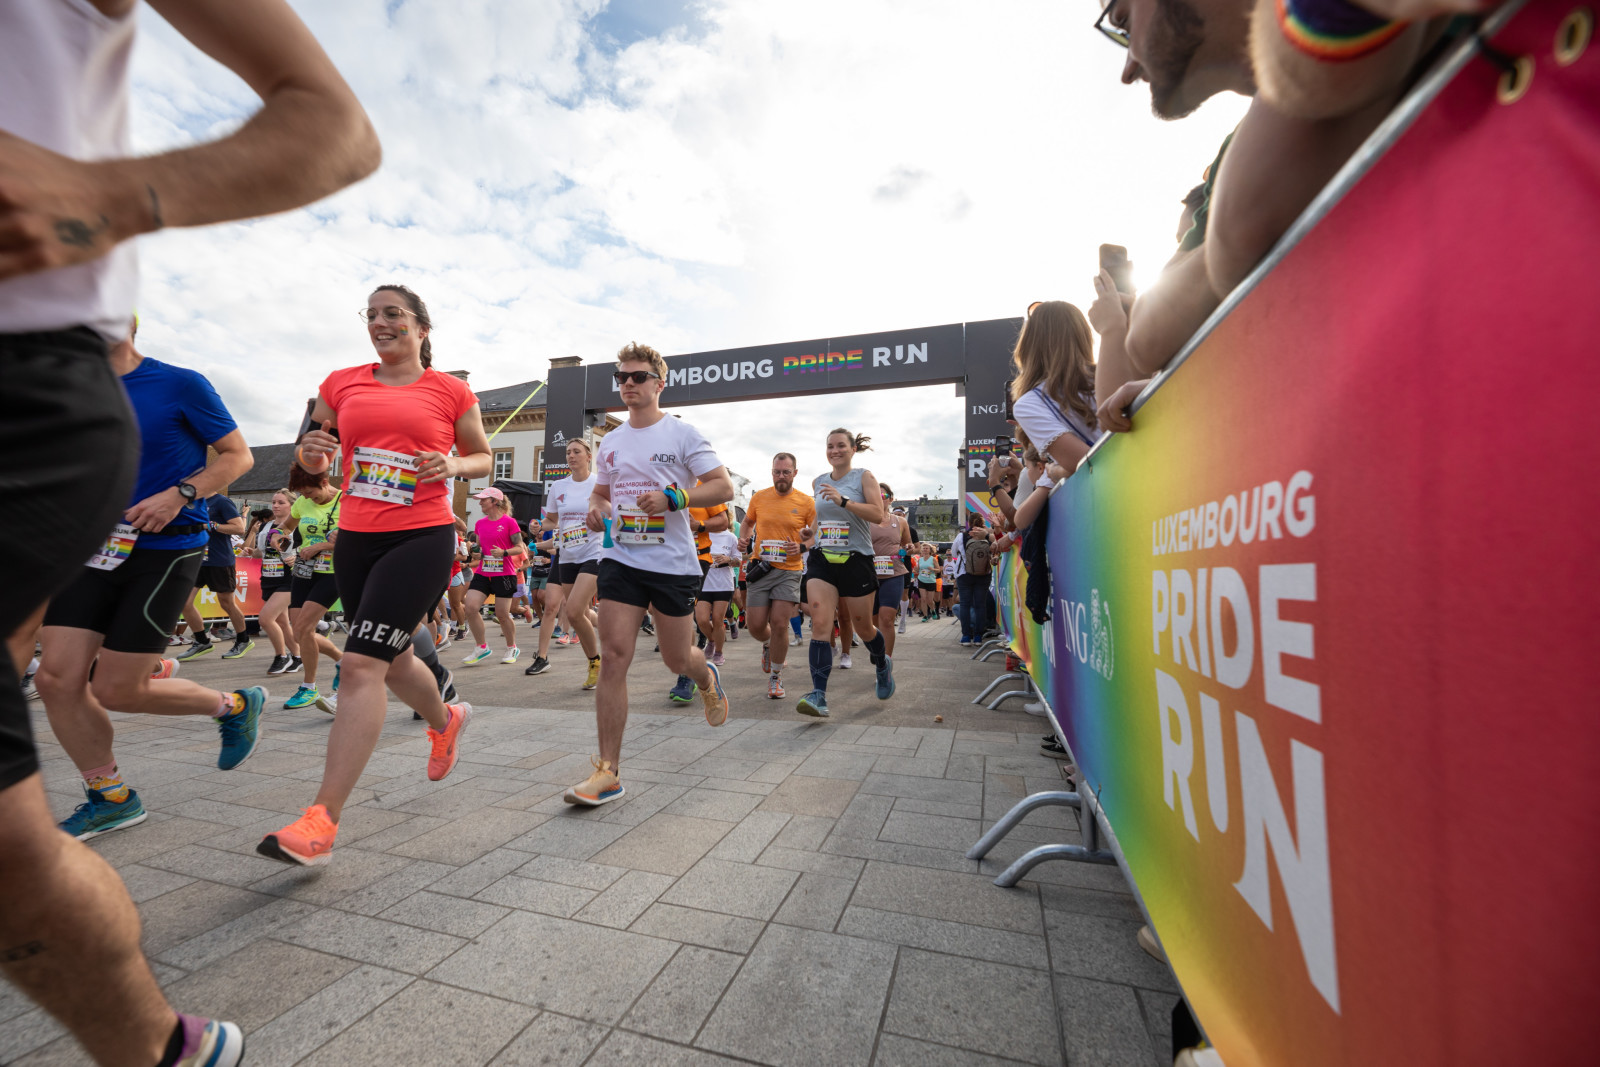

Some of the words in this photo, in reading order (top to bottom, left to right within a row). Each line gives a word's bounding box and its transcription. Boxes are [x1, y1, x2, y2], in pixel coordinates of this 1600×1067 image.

[612, 359, 774, 392] LMBOURG
[784, 349, 864, 375] PRIDE
[872, 342, 928, 367] RUN
[972, 404, 998, 415] ING
[394, 457, 410, 465] RUN
[968, 444, 1023, 458] PRIE
[367, 463, 402, 489] 824
[545, 469, 572, 479] PRID
[1151, 470, 1316, 556] LUXEMBOURG
[634, 516, 649, 533] 57
[200, 587, 247, 604] RN
[1060, 598, 1088, 664] ING
[1151, 562, 1322, 724] PRIDE
[1155, 667, 1341, 1016] RUN
